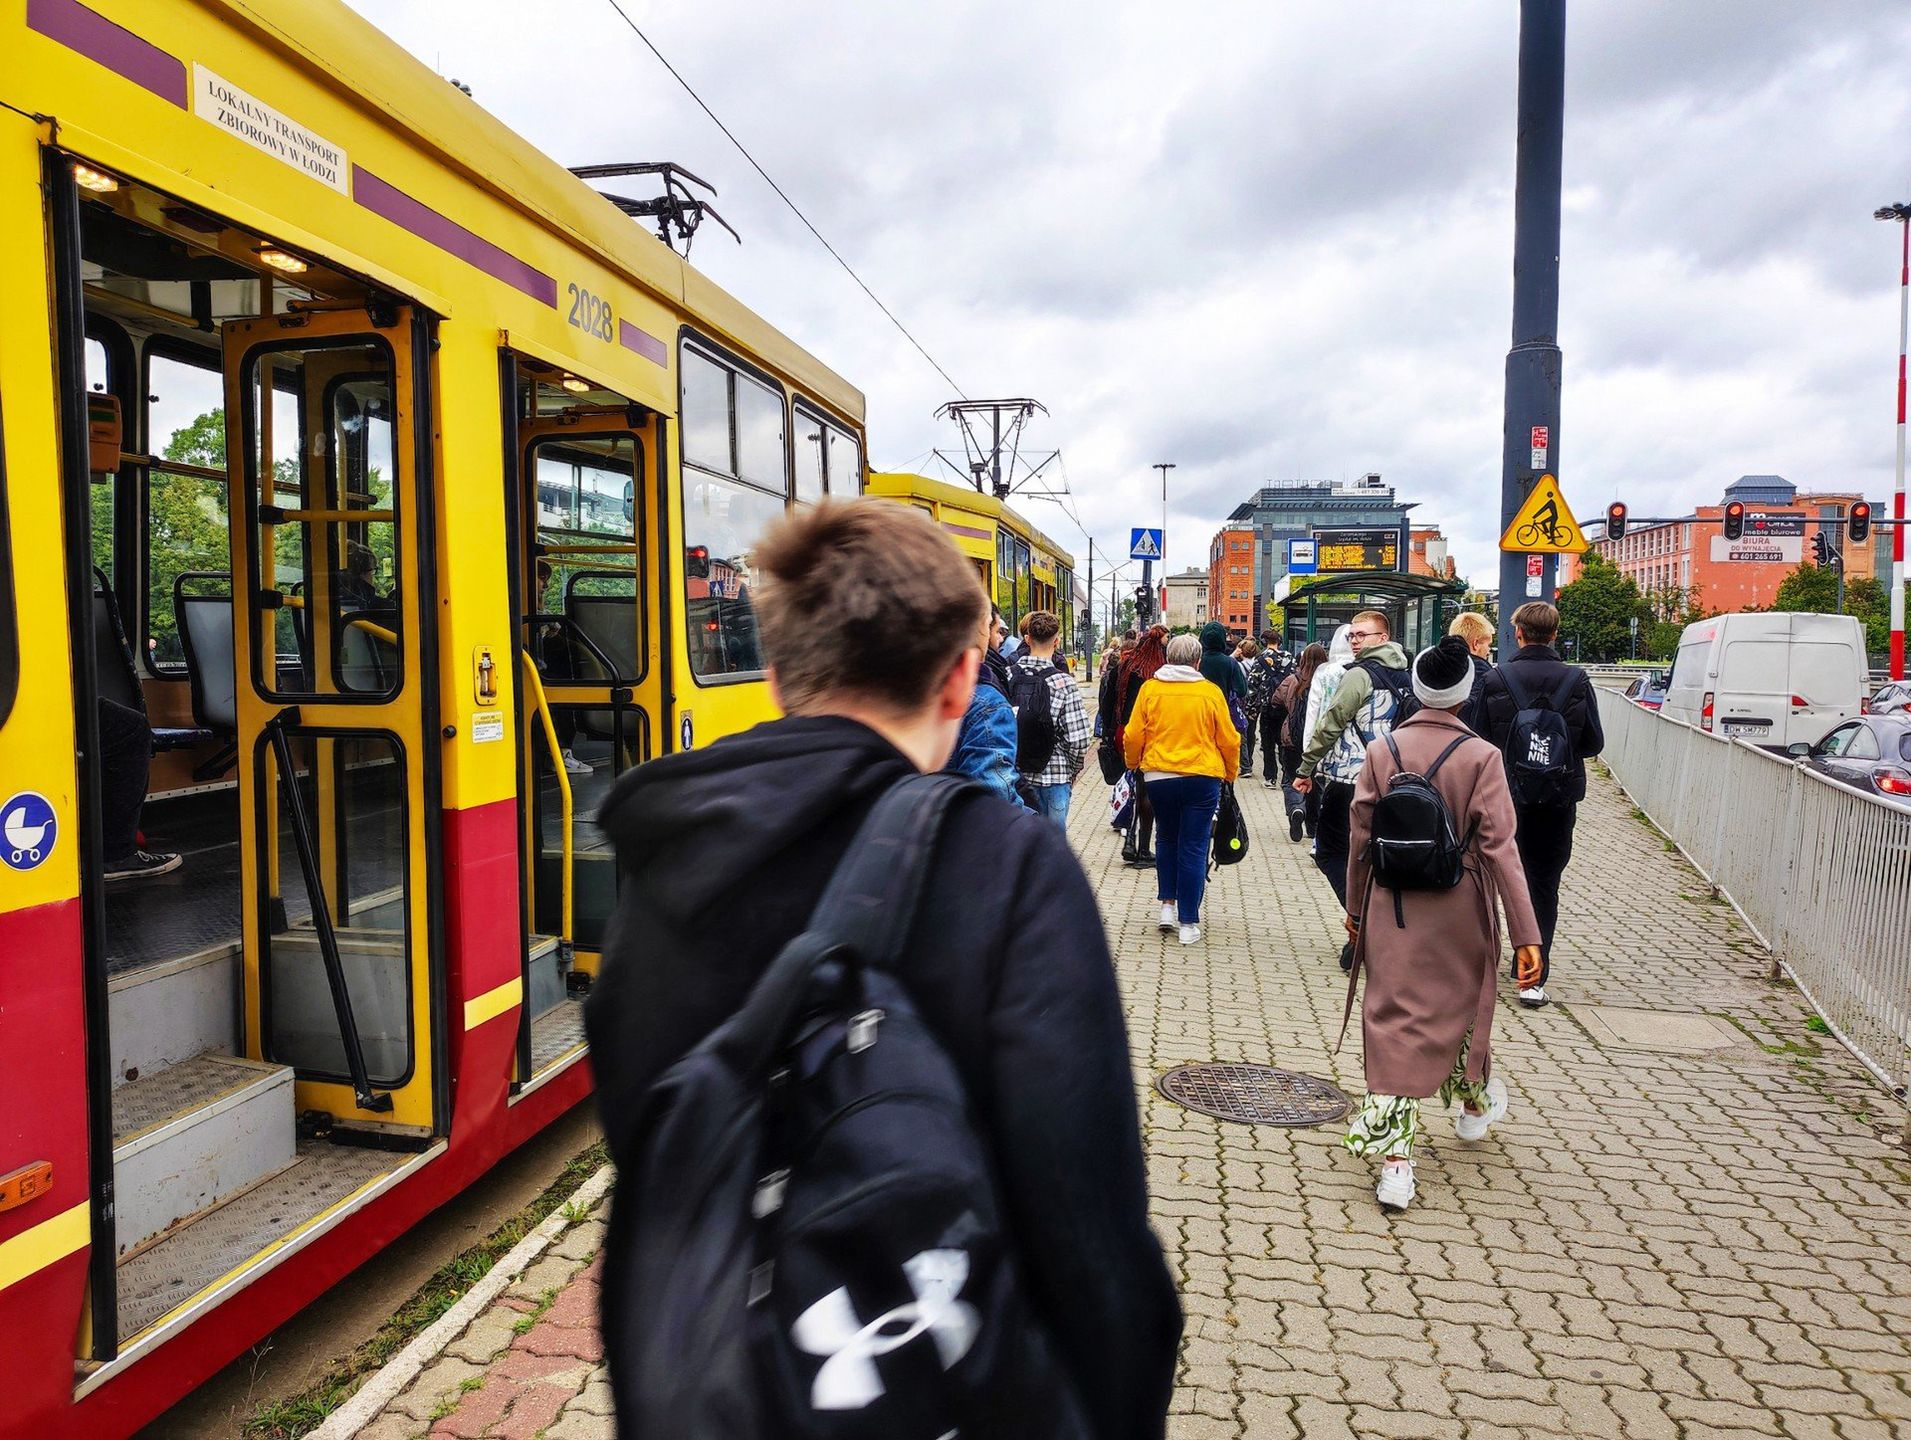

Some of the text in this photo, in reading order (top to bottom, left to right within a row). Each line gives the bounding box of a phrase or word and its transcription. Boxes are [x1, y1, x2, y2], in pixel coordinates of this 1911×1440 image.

[208, 79, 340, 167] LOKALNY TRANSPORT
[217, 106, 337, 184] ZBIOROWY W ŁODZI
[567, 282, 613, 344] 2028
[1742, 537, 1770, 545] BIURA
